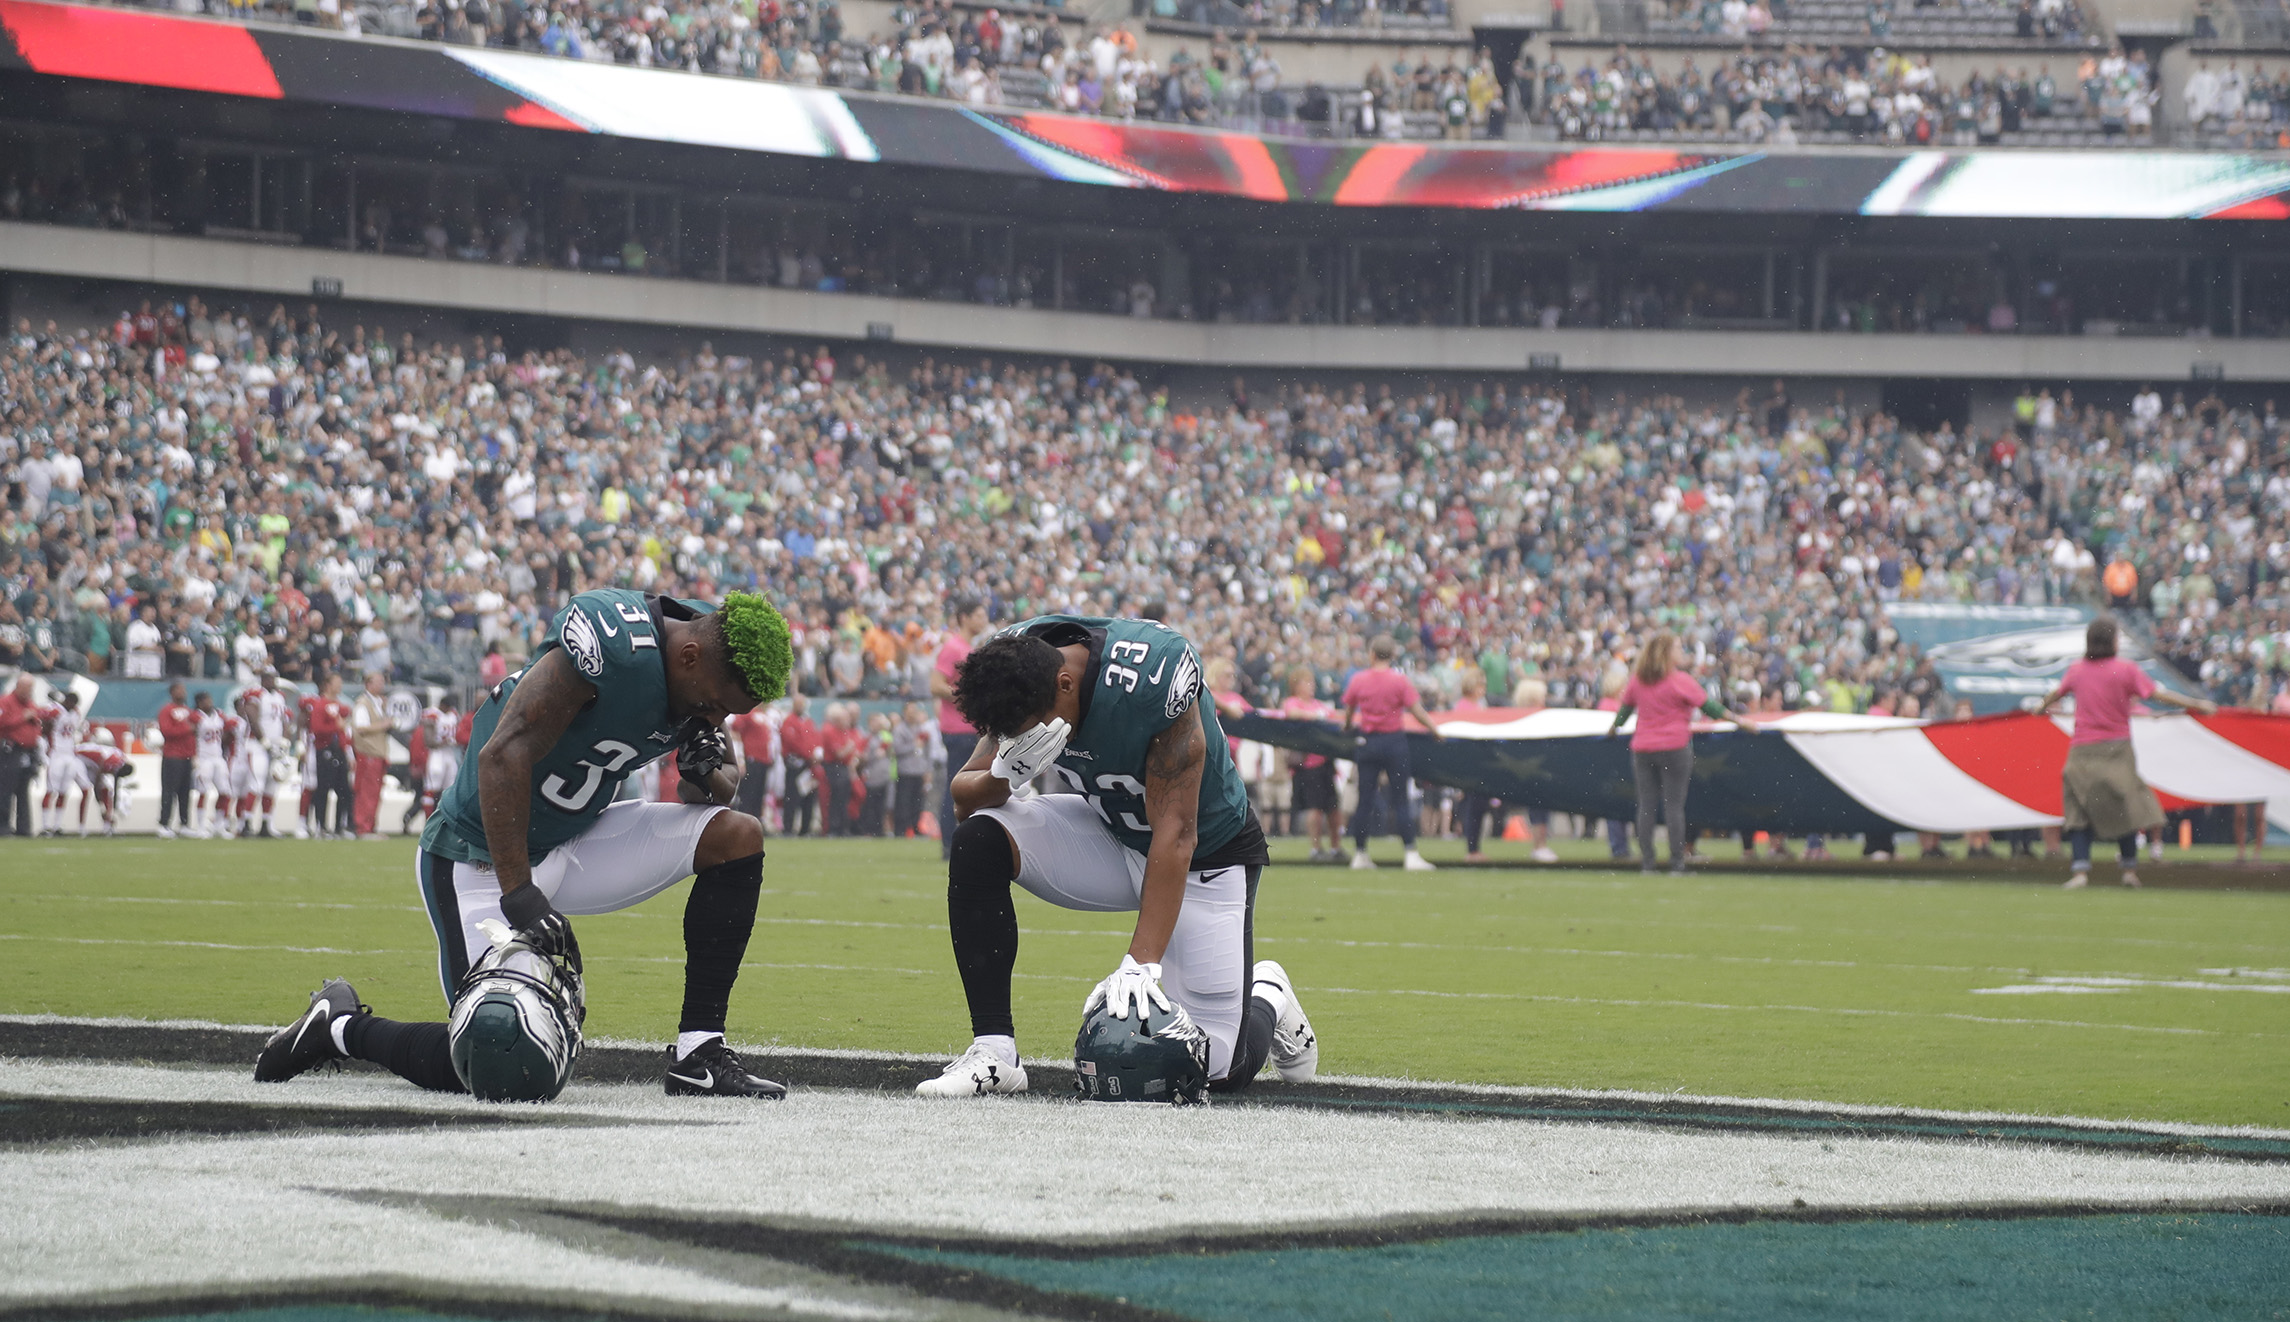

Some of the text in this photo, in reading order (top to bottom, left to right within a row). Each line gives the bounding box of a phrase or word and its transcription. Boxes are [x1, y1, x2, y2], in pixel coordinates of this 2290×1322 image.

[615, 602, 657, 653] 31
[1104, 640, 1150, 694] 33
[541, 740, 655, 814] 3
